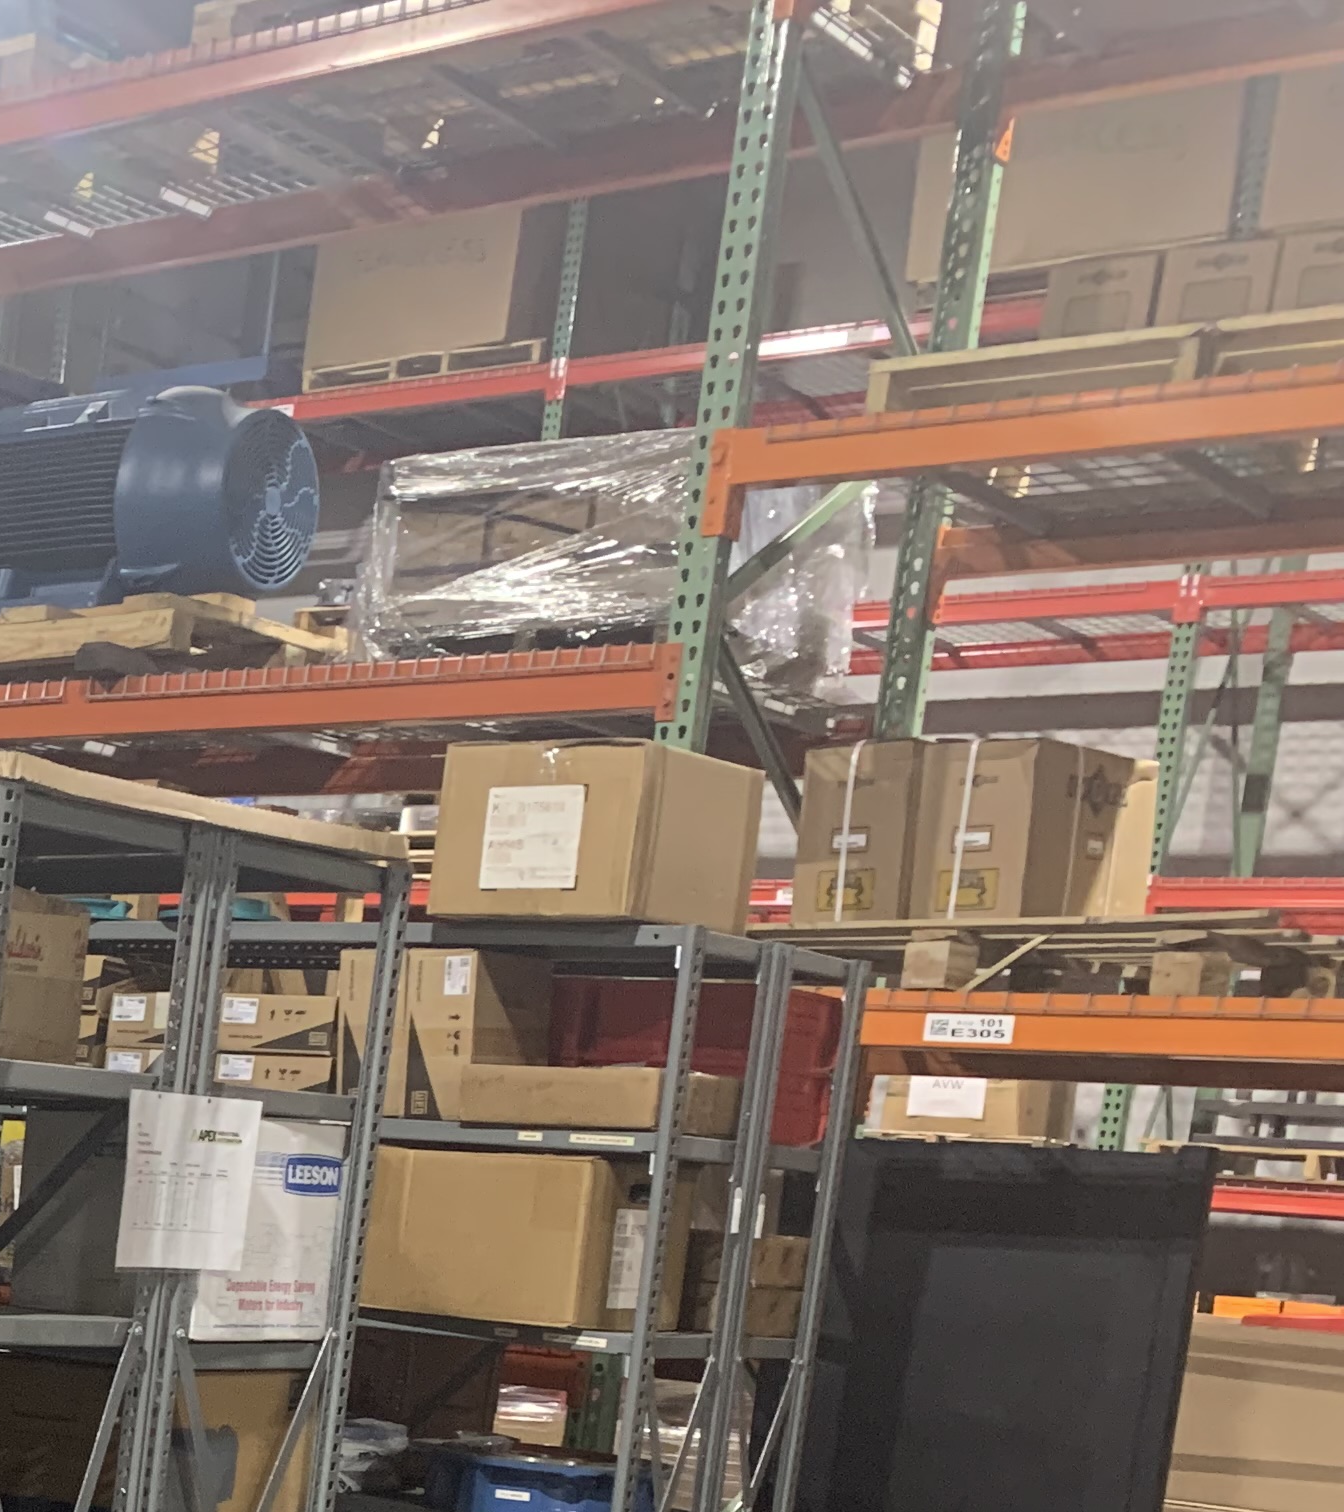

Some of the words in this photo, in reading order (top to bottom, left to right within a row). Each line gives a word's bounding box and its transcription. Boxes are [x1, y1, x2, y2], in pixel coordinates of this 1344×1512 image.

[980, 1018, 1004, 1028] 101
[951, 1028, 1006, 1039] E305
[932, 1079, 965, 1090] AVW
[288, 1164, 339, 1186] LEESON
